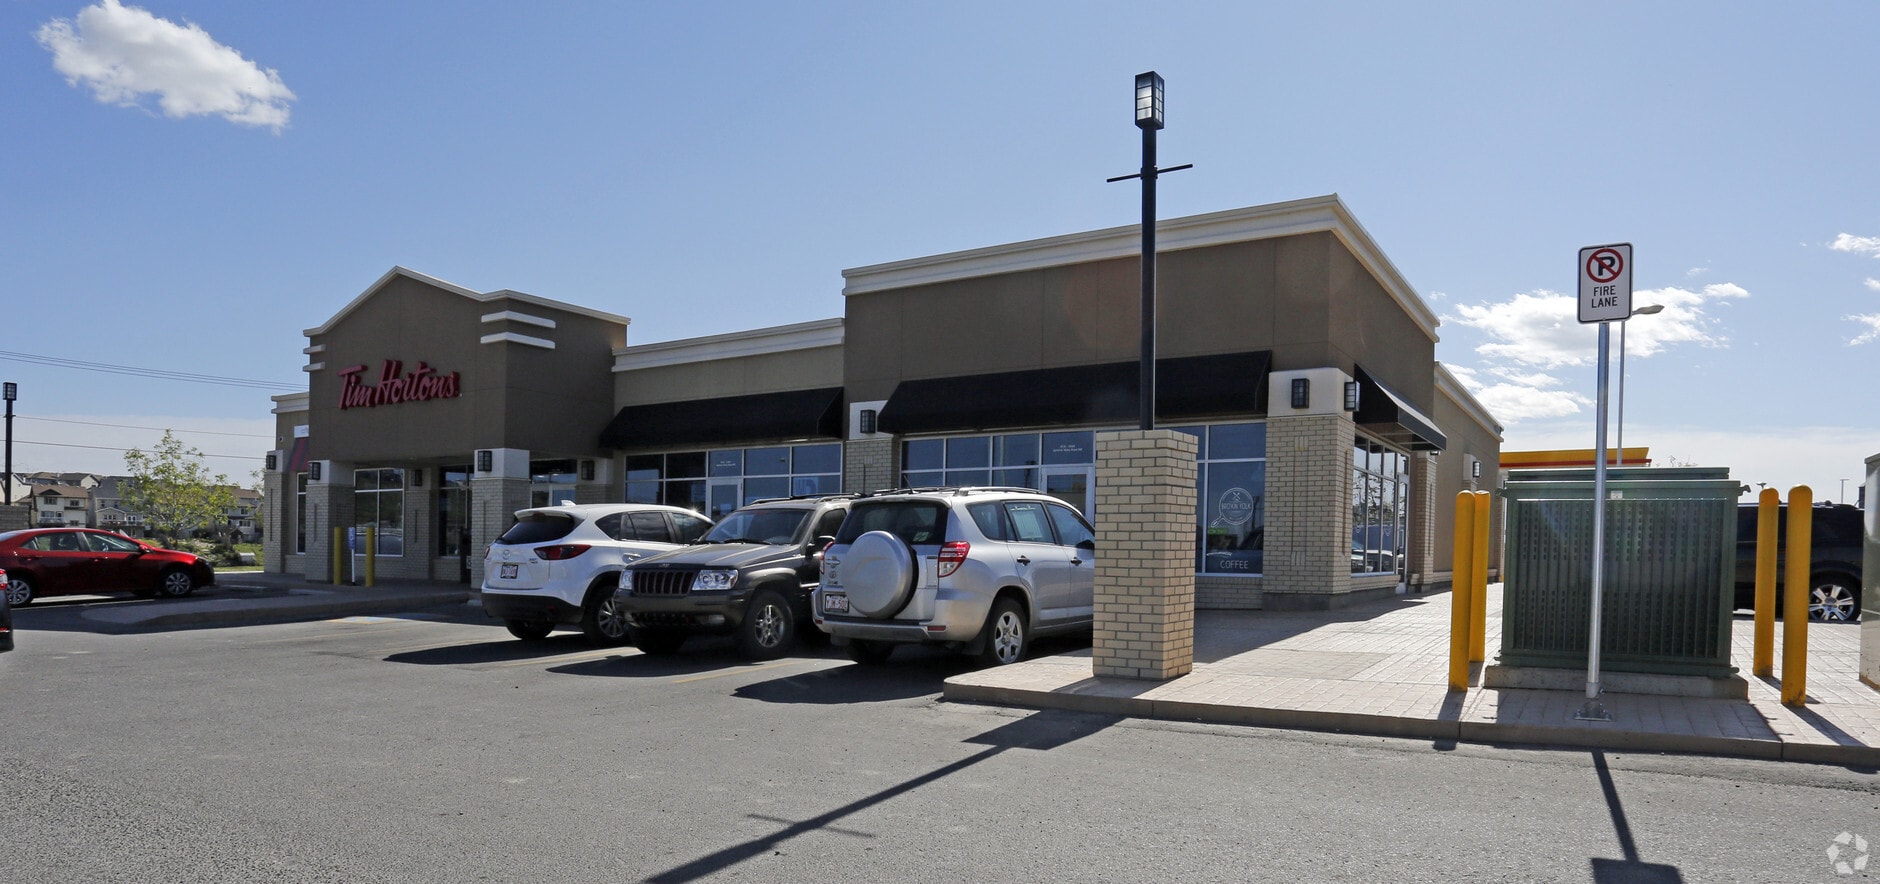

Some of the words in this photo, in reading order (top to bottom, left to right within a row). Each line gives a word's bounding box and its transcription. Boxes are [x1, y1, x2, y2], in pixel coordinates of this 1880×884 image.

[1598, 256, 1616, 276] P
[1594, 285, 1616, 296] FIRE
[1591, 296, 1618, 309] LANE
[337, 364, 375, 410] Tim
[374, 359, 461, 405] Hortons
[1220, 560, 1249, 569] COFFEE
